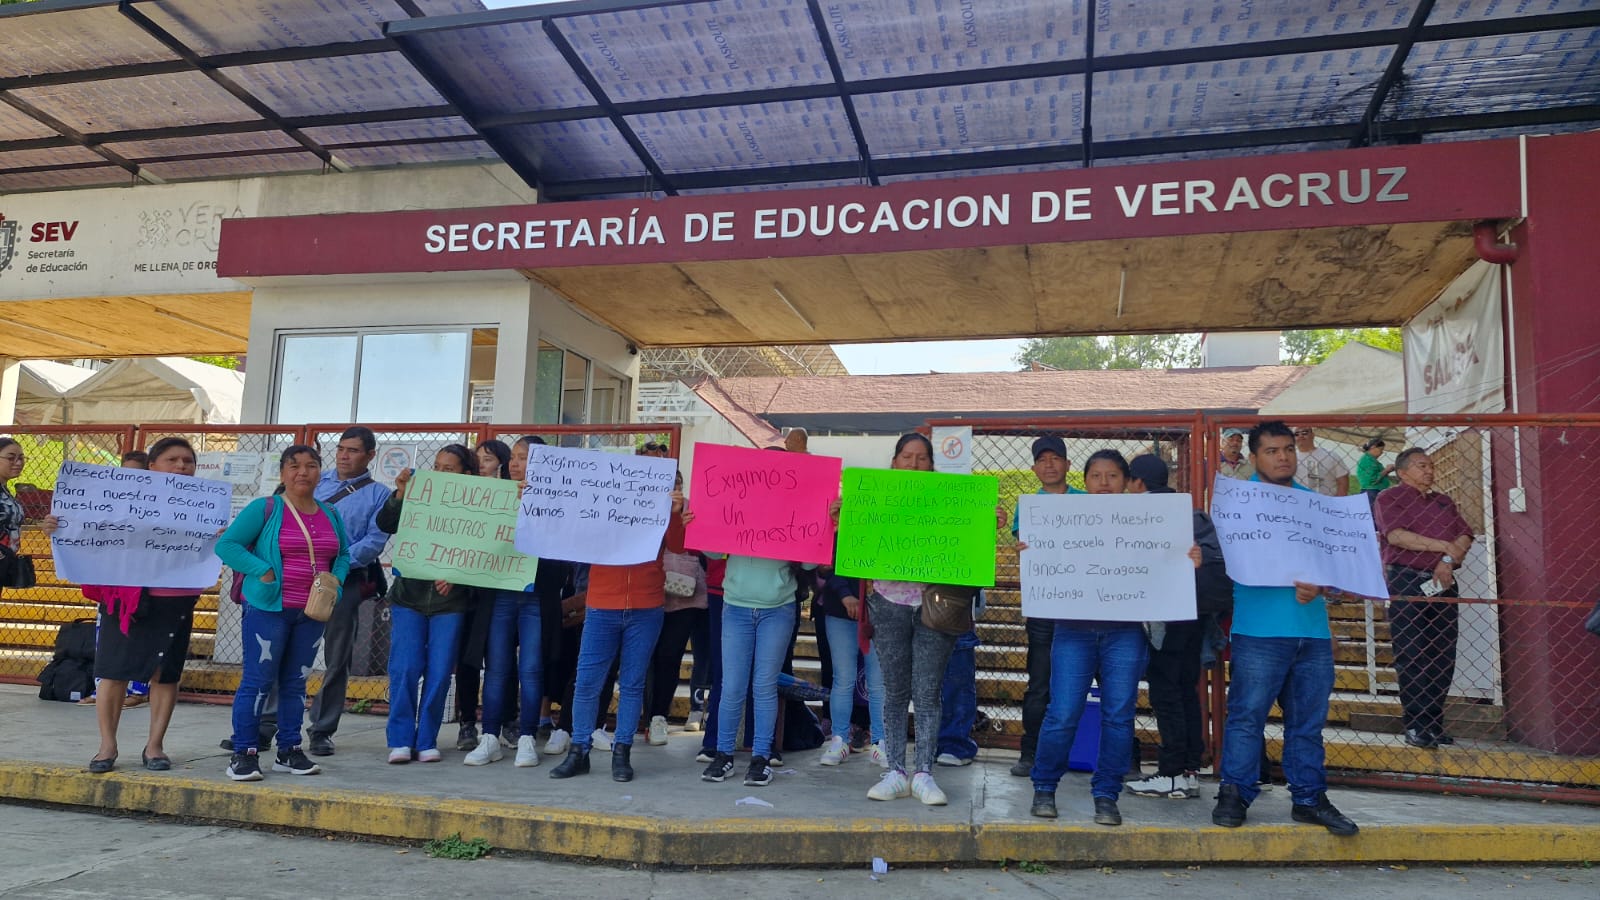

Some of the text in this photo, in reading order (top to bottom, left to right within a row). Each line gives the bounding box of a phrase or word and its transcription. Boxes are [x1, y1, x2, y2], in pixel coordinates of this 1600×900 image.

[828, 4, 856, 59] PLASKOLITE
[705, 17, 739, 71] PLASKOLITE
[588, 30, 630, 82] PLASKOLITE
[425, 166, 1409, 253] SECRETARÍA DE EDUCACION DE VERACRUZ
[30, 220, 79, 243] SEV
[28, 248, 75, 260] Secretaría
[26, 260, 88, 273] de Educación
[134, 264, 147, 272] ME
[150, 262, 179, 272] LLENA
[182, 262, 194, 271] DE
[529, 447, 673, 481] Exigimos Maestros
[61, 463, 228, 496] Nesecitamos Maestros
[405, 477, 433, 503] LA
[526, 469, 670, 497] Para la escuela Ignacio
[704, 465, 798, 500] Exigimos
[56, 482, 85, 497] Para
[103, 488, 157, 502] nuestra
[167, 495, 216, 510] escuela
[523, 484, 578, 500] Zaragosa
[633, 498, 656, 509] nos
[846, 494, 878, 507] PARA
[885, 496, 938, 507] ESCUELA
[53, 499, 113, 512] nuestros
[129, 503, 161, 520] hijos
[173, 511, 187, 521] ya
[523, 503, 565, 518] Vamos
[607, 508, 667, 527] Respuesta
[723, 503, 745, 526] Un
[845, 510, 900, 526] IGNACIO
[1111, 512, 1165, 524] Maestro
[1308, 498, 1370, 521] Maestros
[83, 521, 136, 532] meses
[402, 511, 422, 529] DE
[427, 514, 488, 539] NUESTROS
[1212, 504, 1368, 540] Para nuestra escuela
[145, 540, 202, 554] Respuesta
[851, 535, 866, 548] DE
[1028, 534, 1171, 549] Para escuela Primaria
[1285, 530, 1357, 555] Zaragoza
[397, 541, 528, 574] ES IMPORTANTE
[1028, 560, 1149, 576] Ignacio Zaragosa
[1096, 588, 1146, 602] Veracruz
